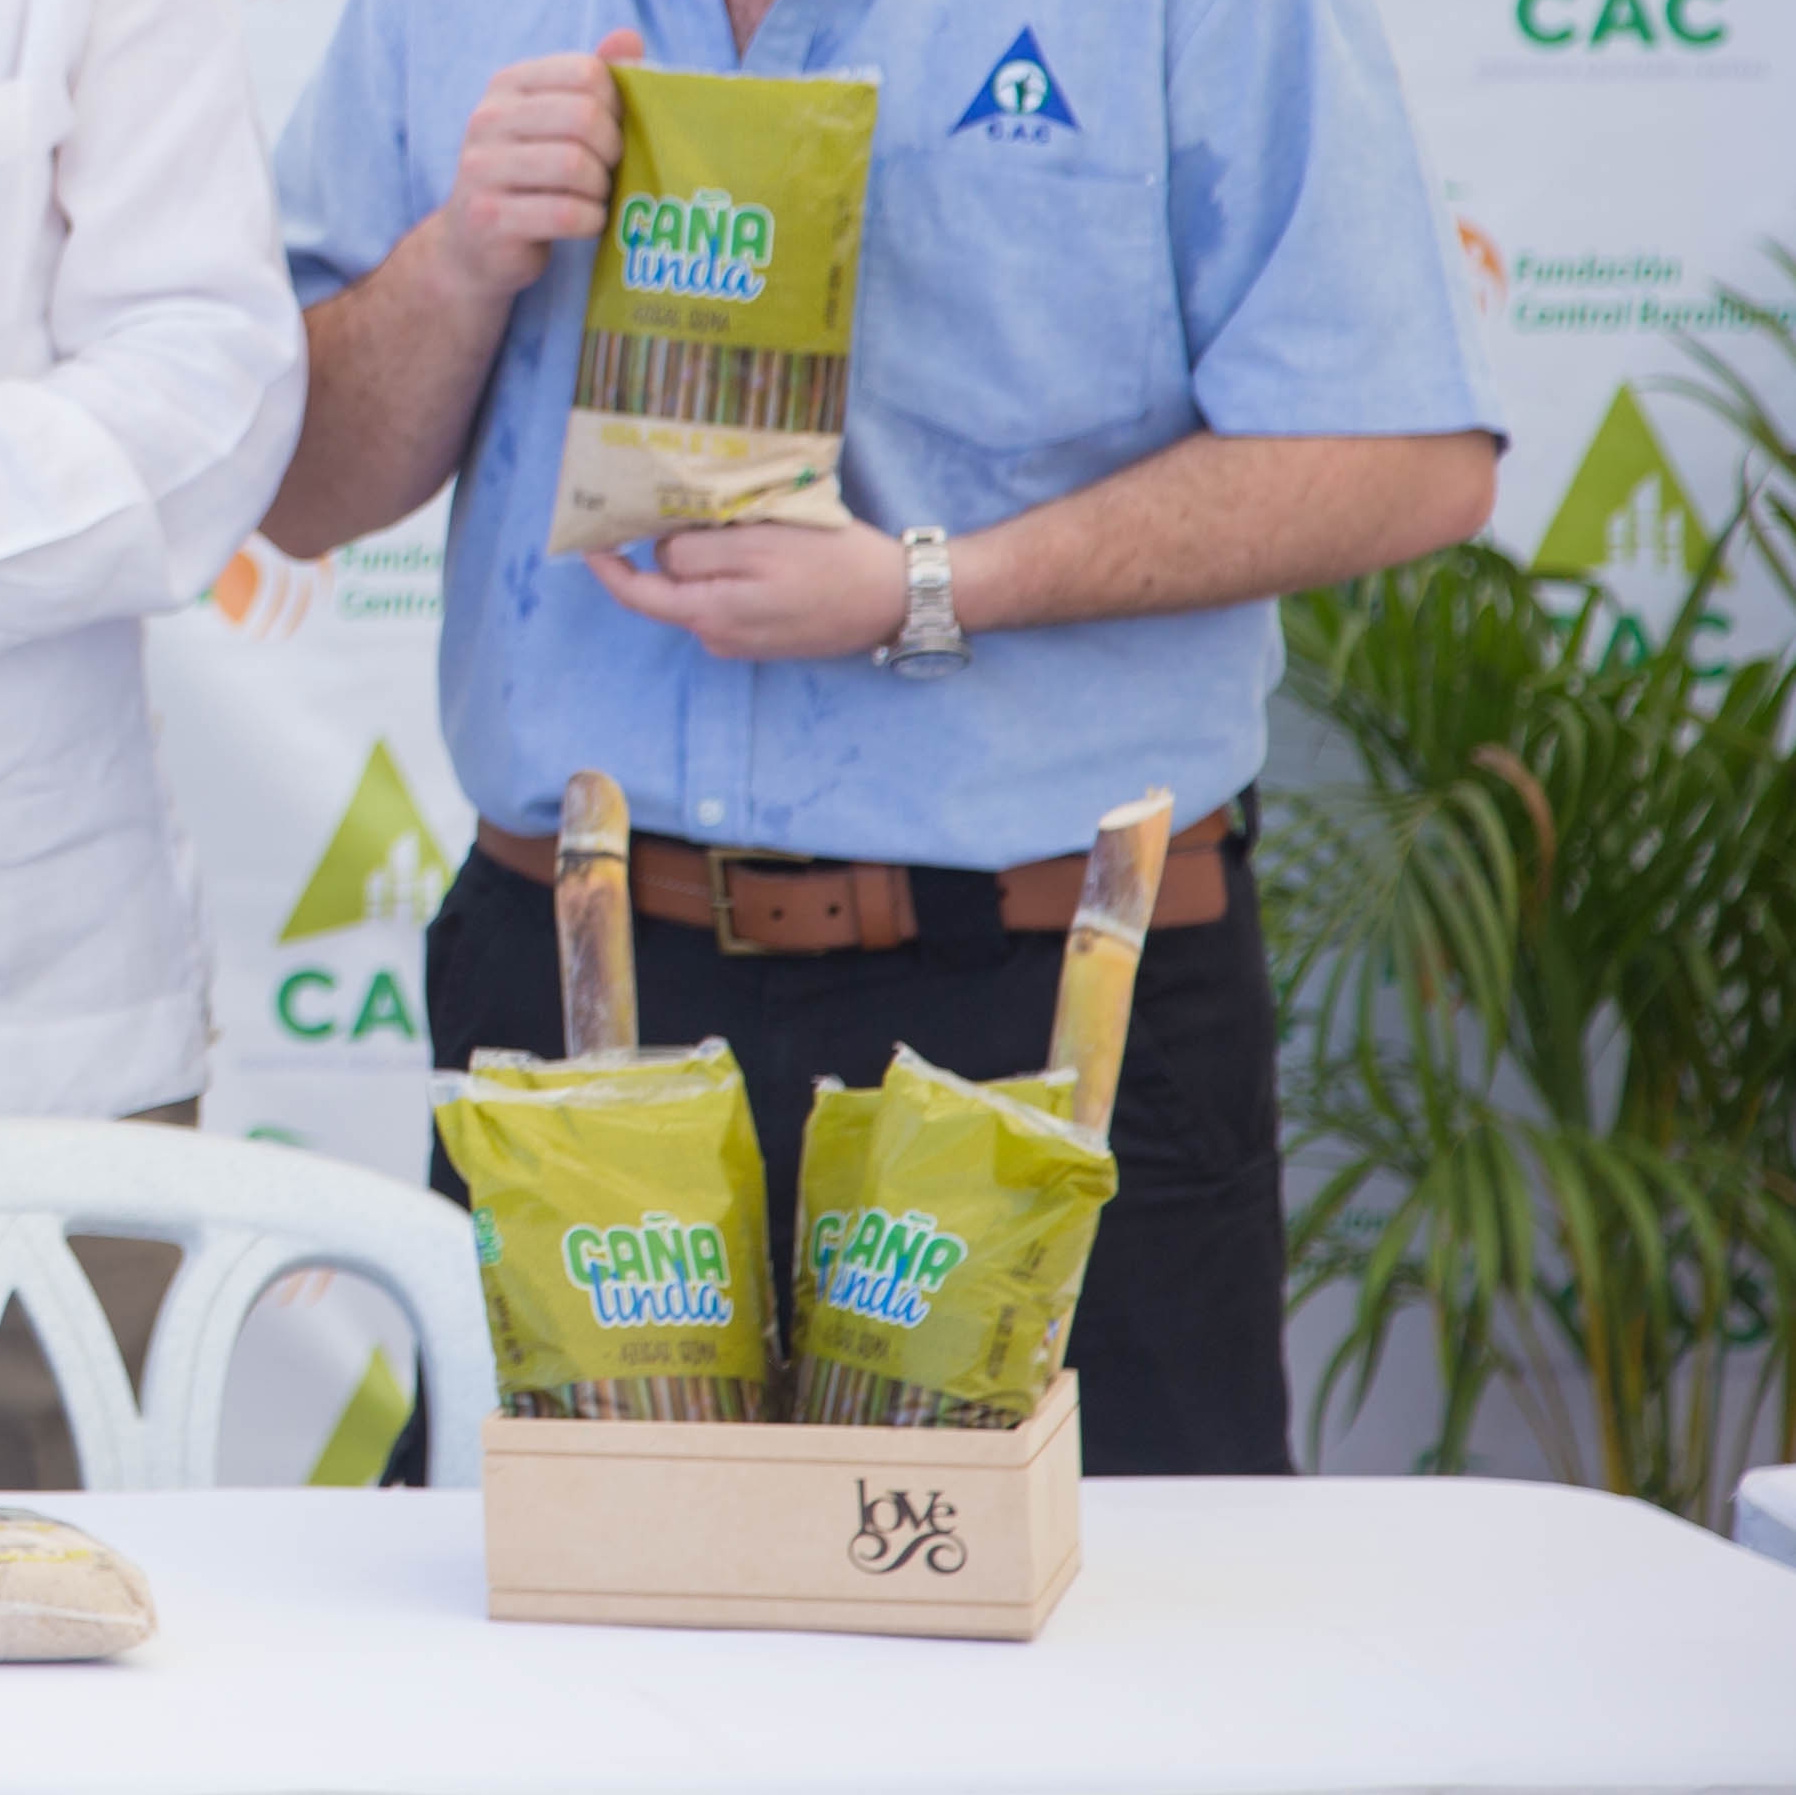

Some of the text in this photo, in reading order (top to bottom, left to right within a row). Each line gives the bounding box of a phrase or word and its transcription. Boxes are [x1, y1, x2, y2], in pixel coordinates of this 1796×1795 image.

[621, 191, 771, 259] CAÑA
[627, 224, 765, 297] linda
[1552, 612, 1731, 680] AC
[274, 968, 416, 1040] CA
[566, 1214, 726, 1285] CAÑA
[589, 1259, 732, 1324] linda
[849, 1476, 965, 1558] love
